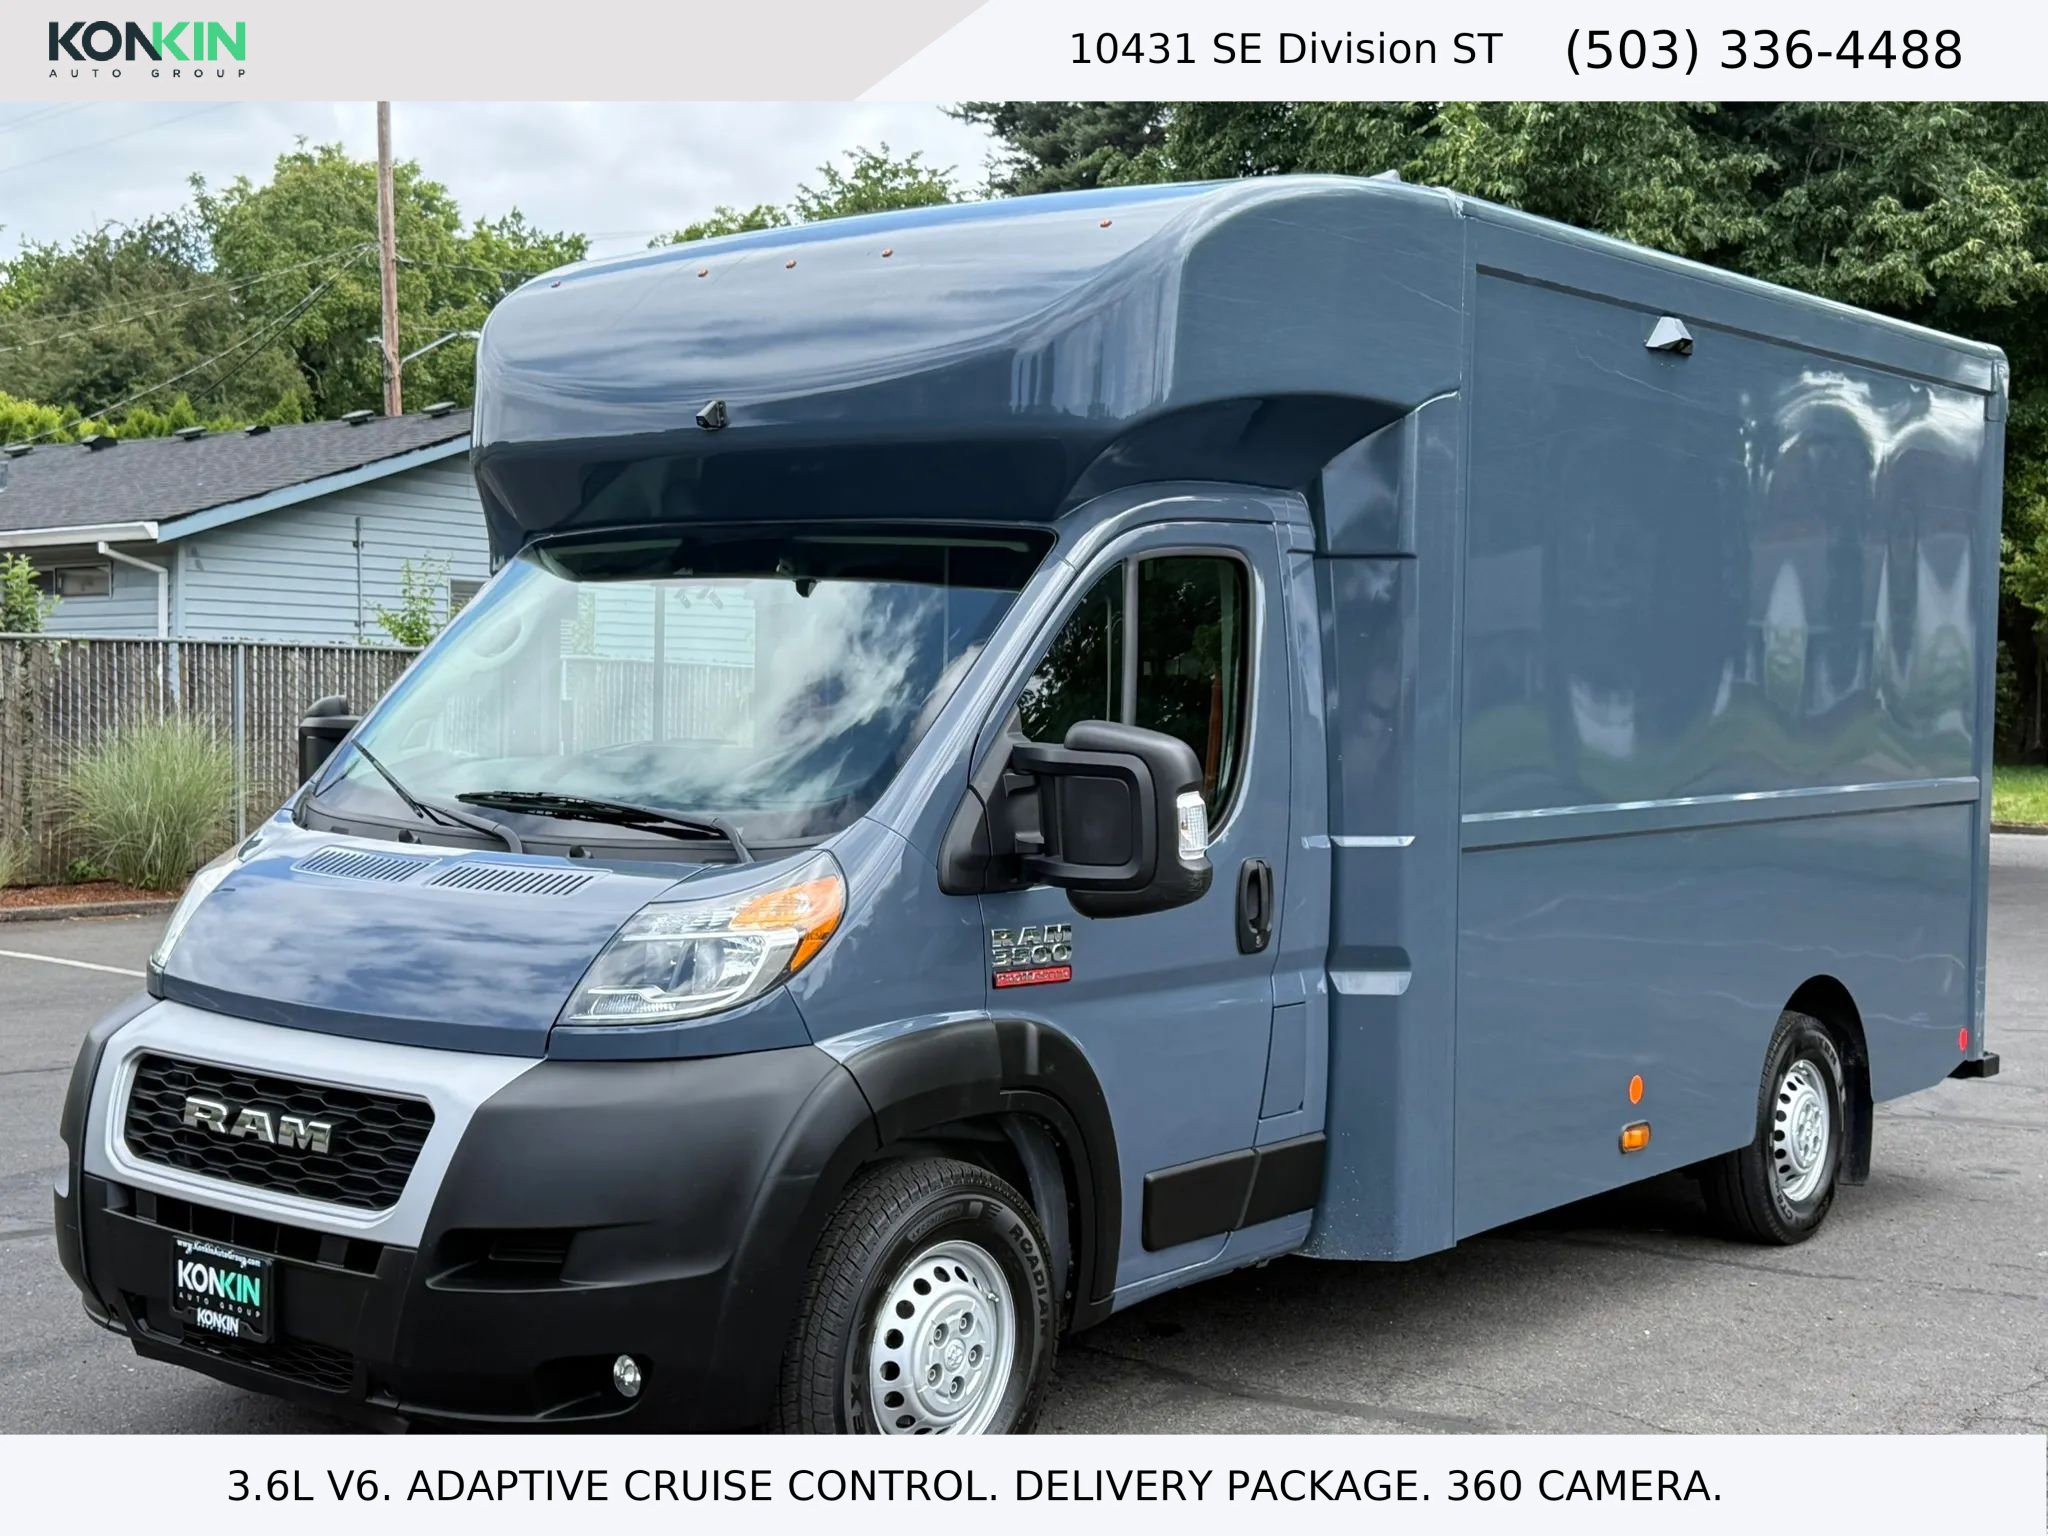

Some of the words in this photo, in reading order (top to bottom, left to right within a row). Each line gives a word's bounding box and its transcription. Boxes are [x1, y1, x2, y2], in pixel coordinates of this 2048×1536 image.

[991, 923, 1072, 947] RAM
[183, 1096, 332, 1154] RAM
[177, 1259, 261, 1307] KONKIN
[179, 1291, 209, 1305] AUTO
[219, 1301, 261, 1318] GROUP
[197, 1307, 240, 1334] KONKIN
